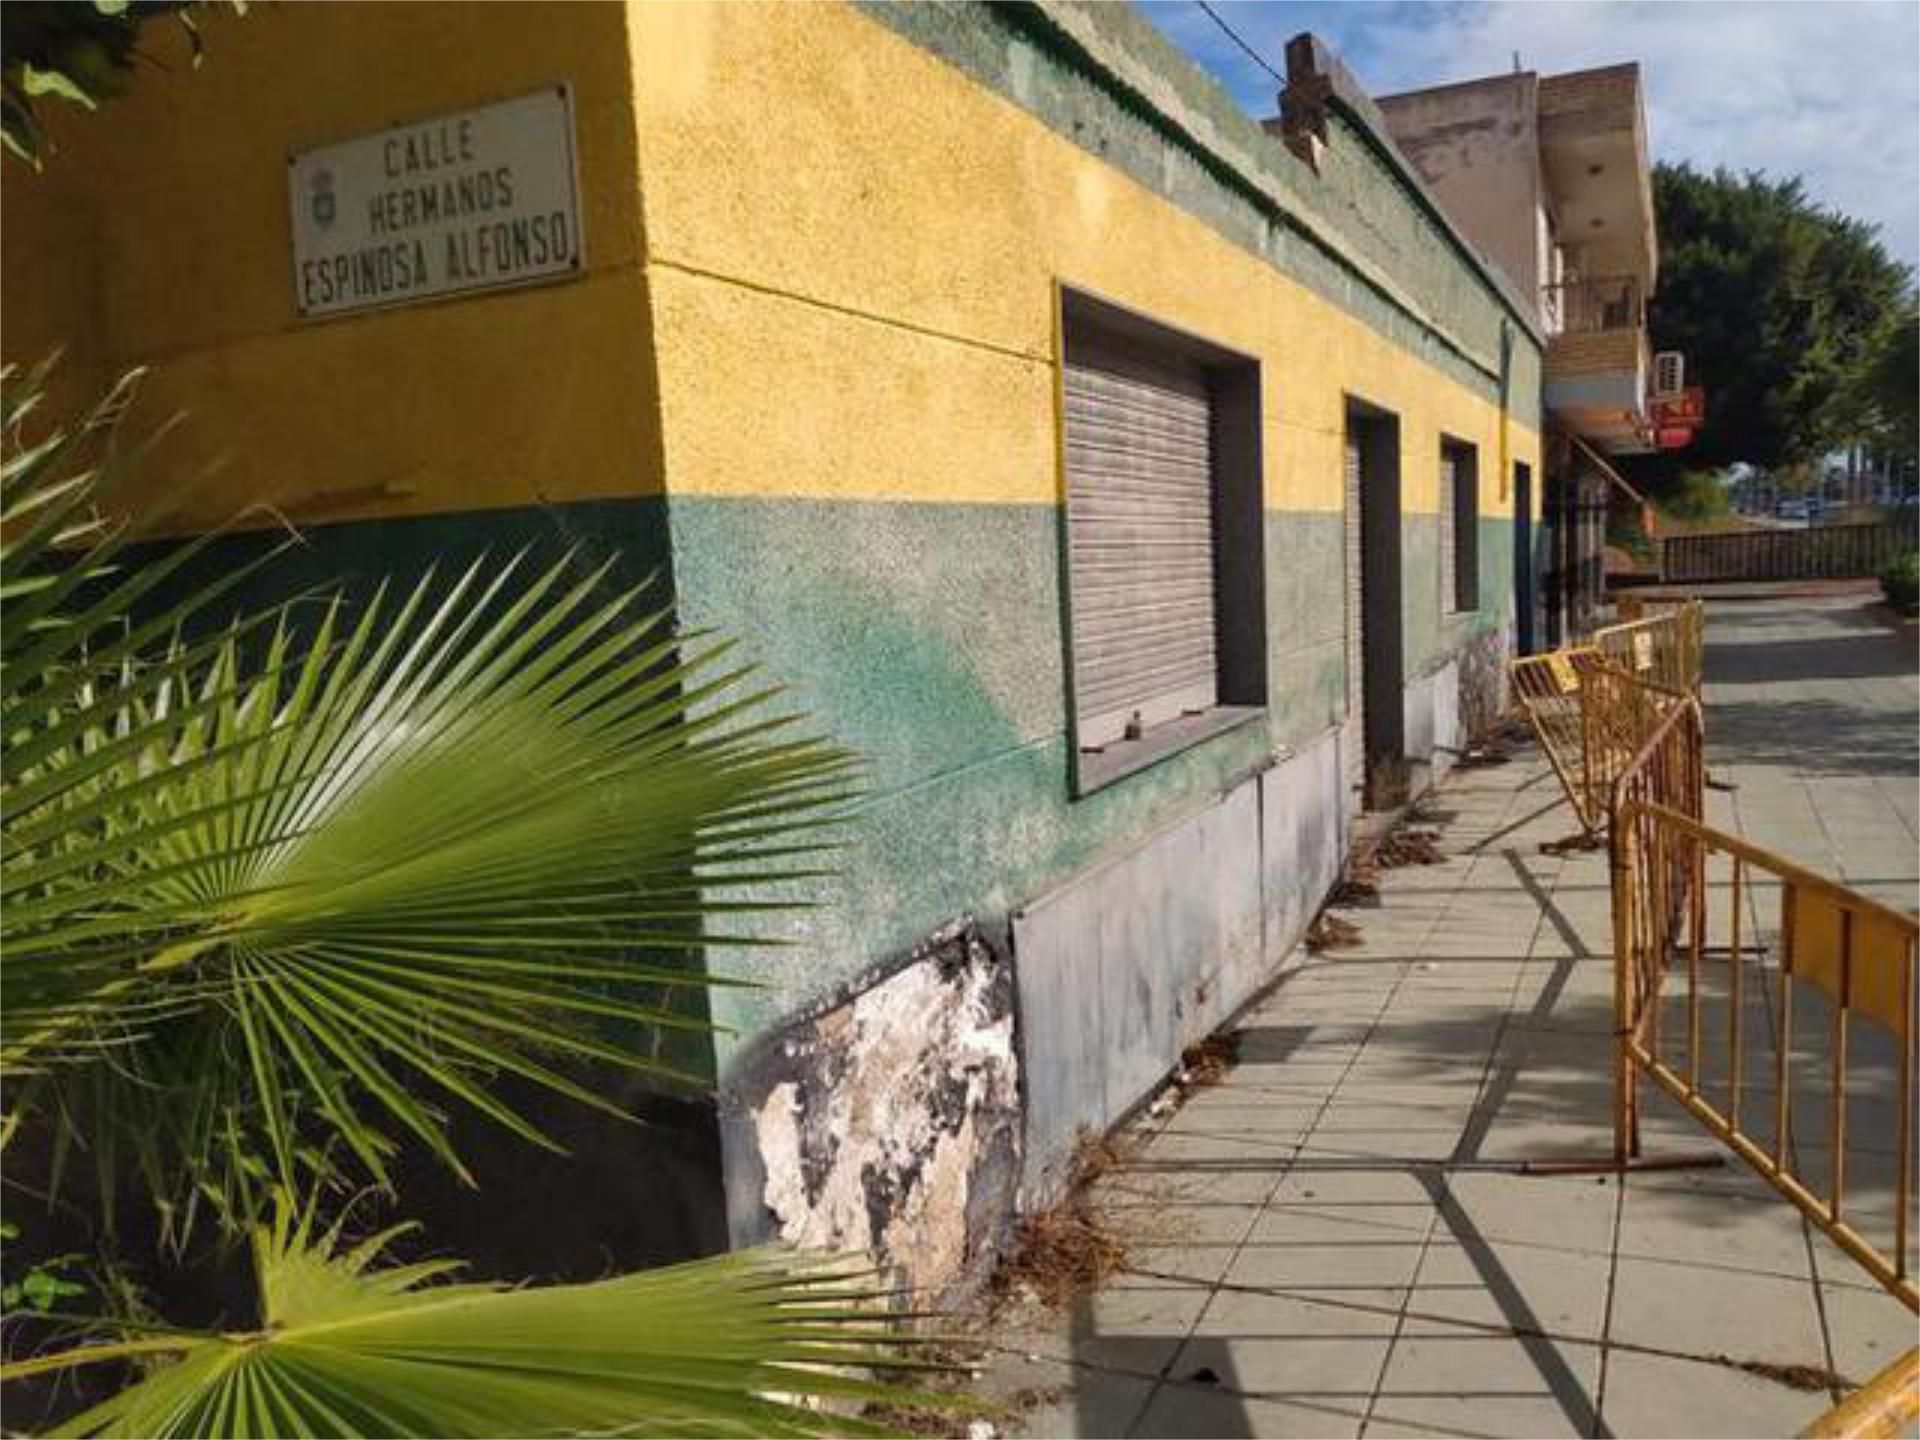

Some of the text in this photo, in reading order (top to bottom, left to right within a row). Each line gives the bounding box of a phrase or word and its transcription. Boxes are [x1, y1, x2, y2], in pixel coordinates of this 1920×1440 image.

[383, 119, 475, 178] CALLE
[369, 167, 514, 235] HERMANOS
[302, 211, 568, 306] ESPINOSA ALFONSO
